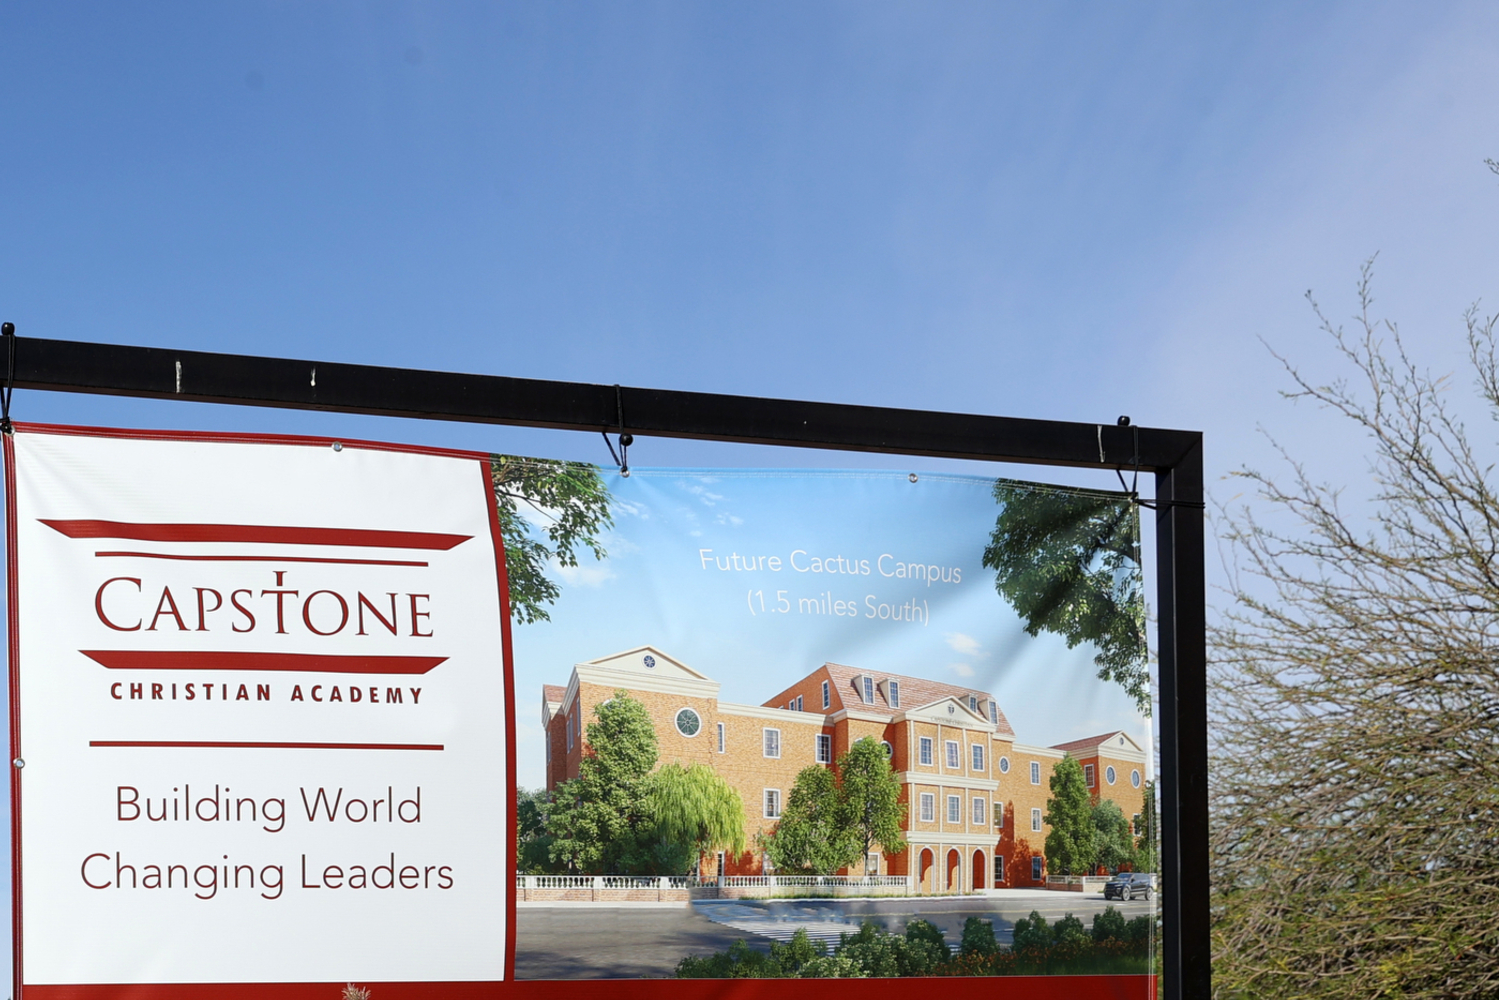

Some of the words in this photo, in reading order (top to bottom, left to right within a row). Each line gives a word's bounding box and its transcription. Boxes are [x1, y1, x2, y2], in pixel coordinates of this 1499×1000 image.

[699, 548, 782, 572] Future
[790, 550, 871, 576] Cactus
[877, 553, 962, 587] Campus
[94, 571, 434, 638] CAPSTONE
[747, 589, 791, 616] (1.5
[798, 591, 857, 618] miles
[865, 594, 930, 627] South)
[110, 681, 271, 702] CHRISTIAN
[290, 684, 422, 705] ACADEMY
[116, 783, 286, 834] Building
[299, 785, 421, 824] World
[80, 850, 284, 901] Changing
[301, 851, 454, 890] Leaders
